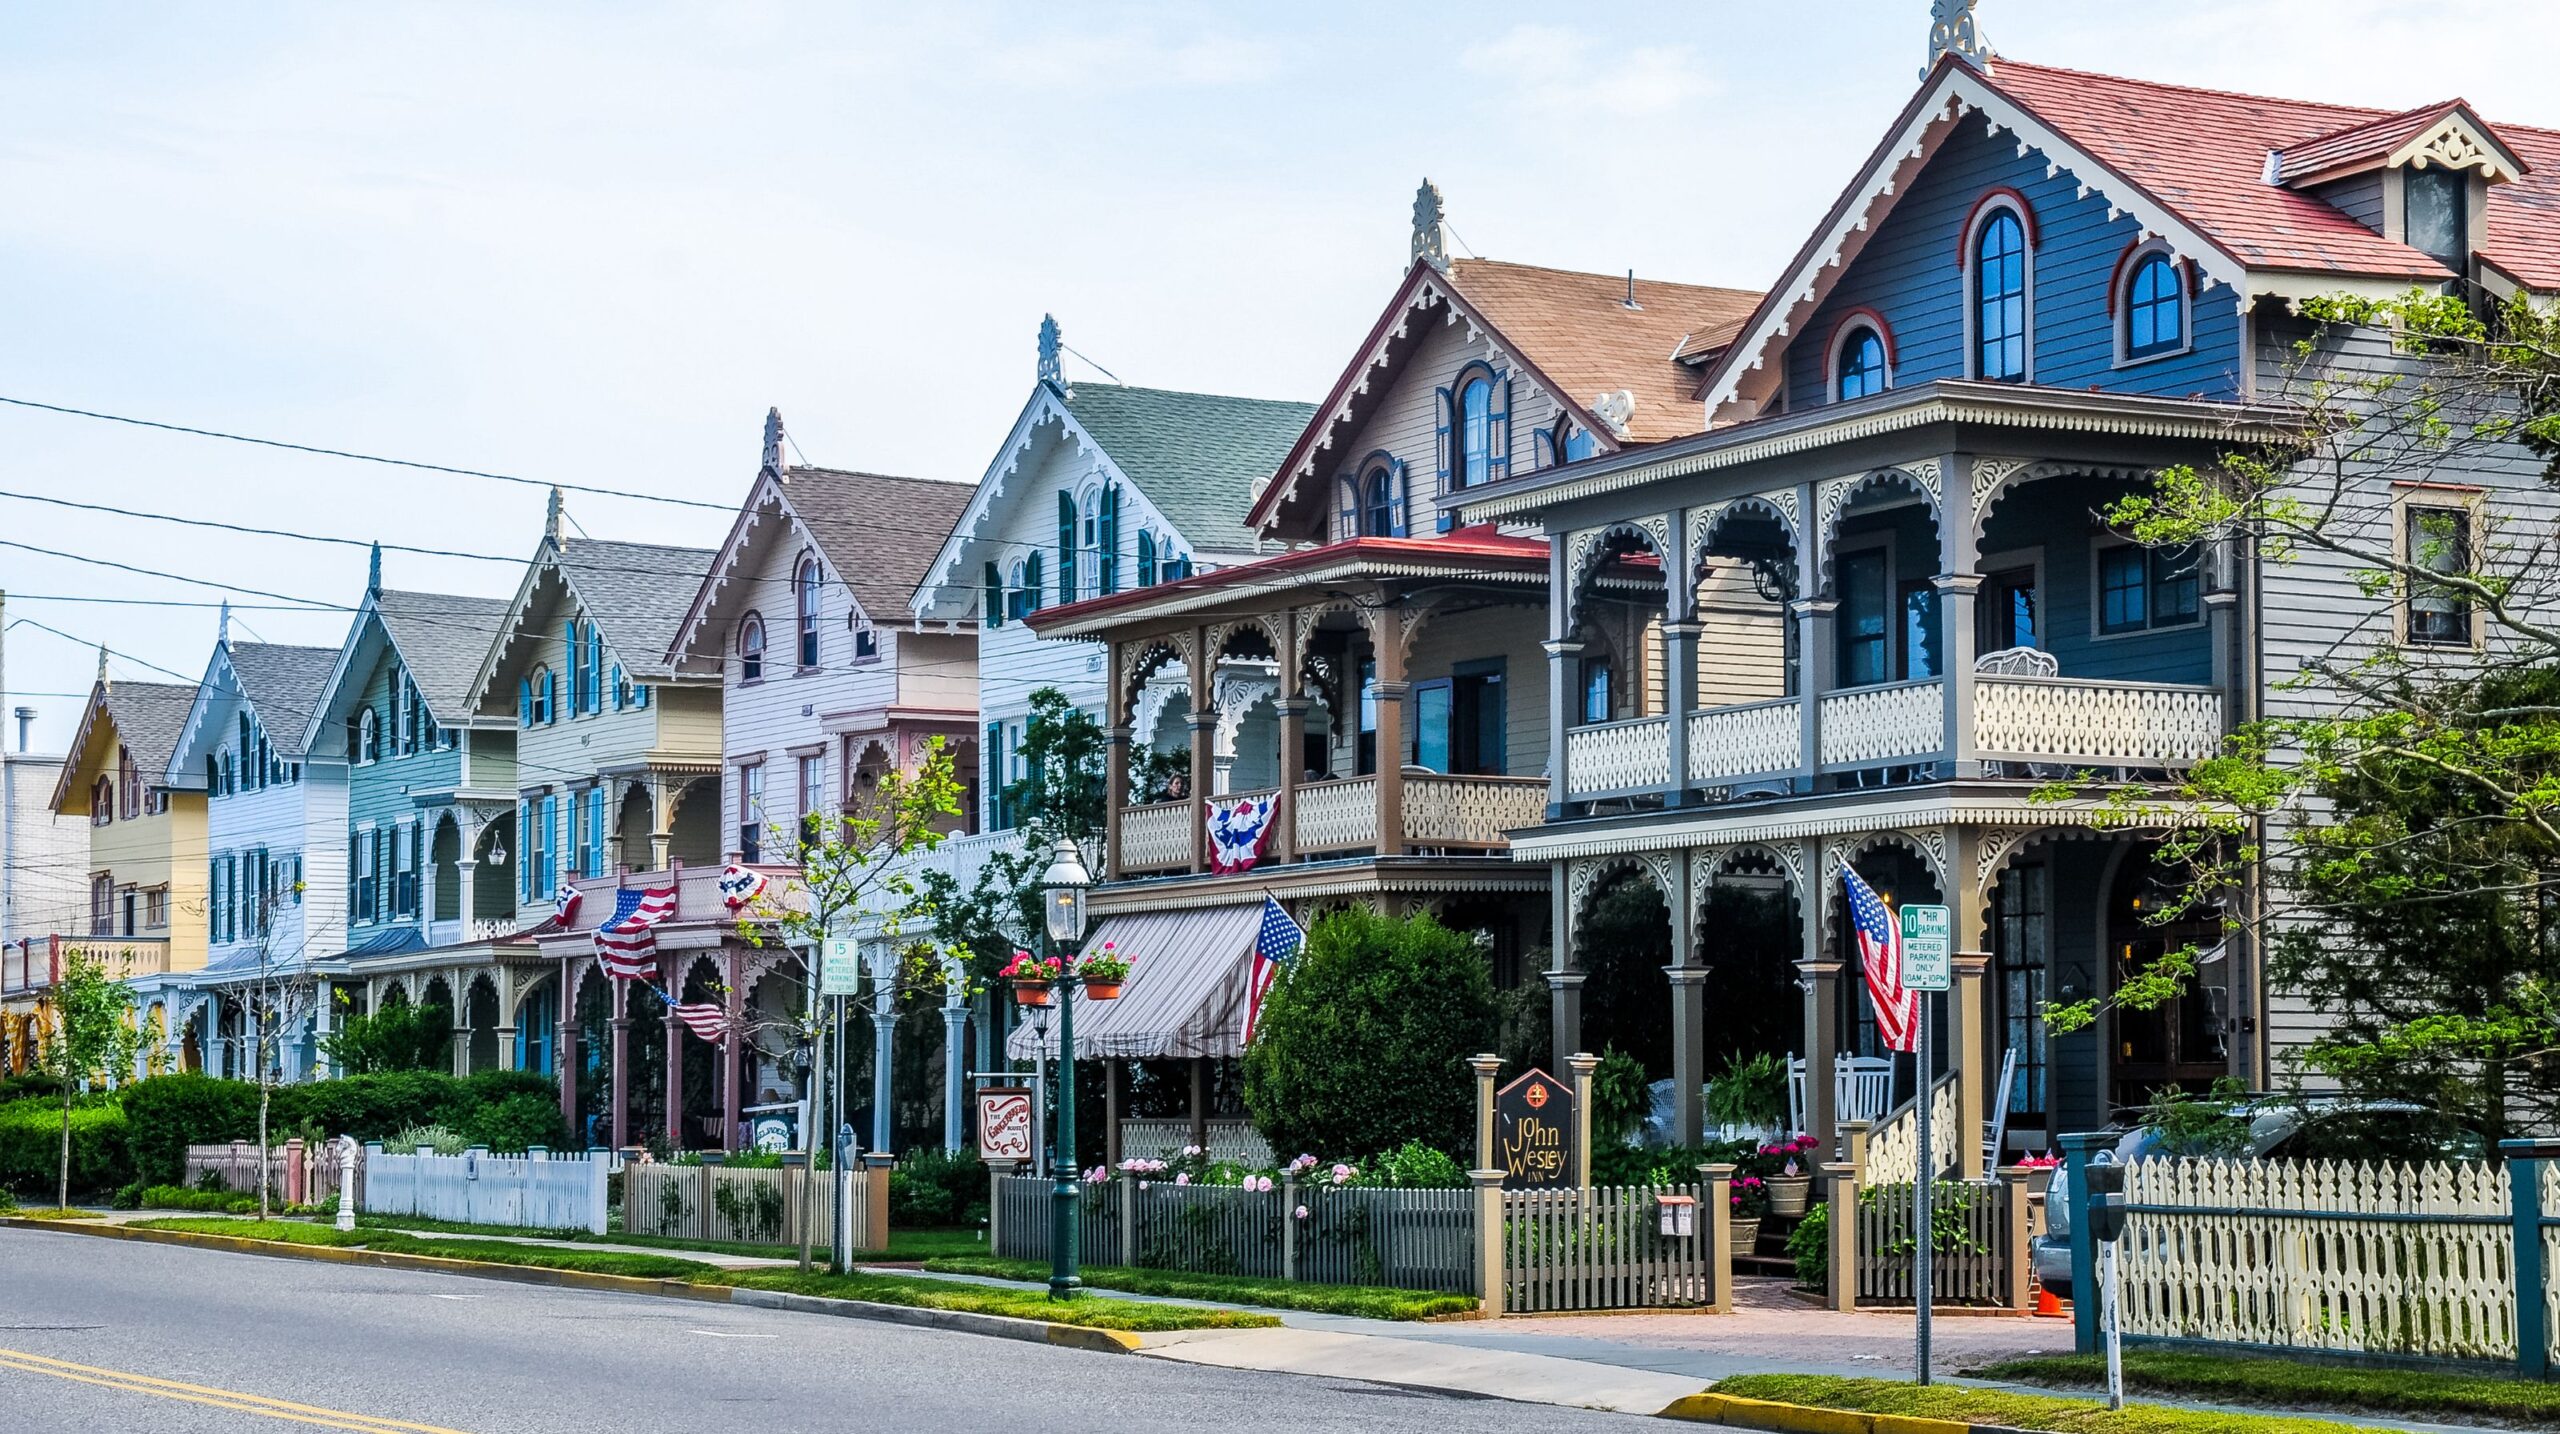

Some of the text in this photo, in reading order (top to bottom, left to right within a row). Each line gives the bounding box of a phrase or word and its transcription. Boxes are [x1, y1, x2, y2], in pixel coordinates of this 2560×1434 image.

[1926, 911, 1938, 921] HR
[1903, 914, 1917, 933] 10
[1918, 924, 1947, 936] PARKING
[834, 942, 847, 955] 15
[1908, 942, 1942, 951] METERED
[829, 957, 851, 965] MINUTE
[1909, 953, 1941, 962] PARKING
[825, 966, 854, 974] METERED
[1915, 963, 1934, 972] ONLY
[1527, 1171, 1544, 1183] INN
